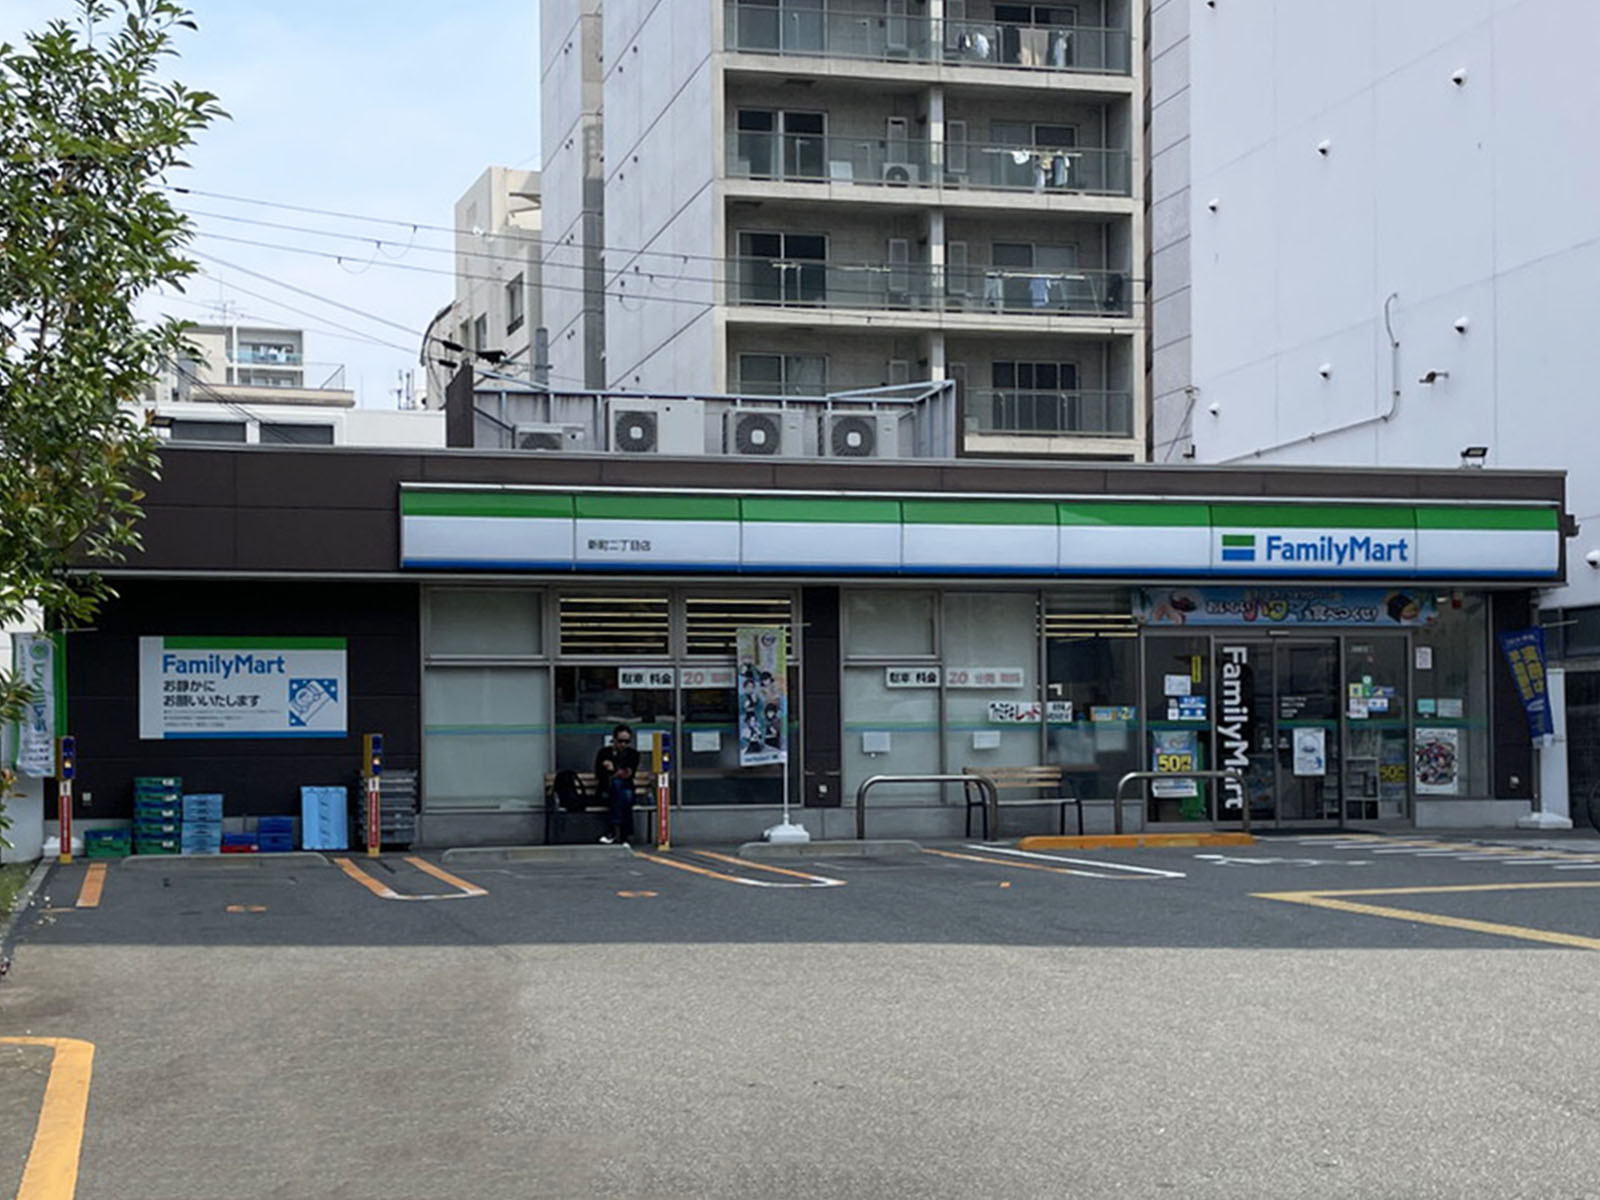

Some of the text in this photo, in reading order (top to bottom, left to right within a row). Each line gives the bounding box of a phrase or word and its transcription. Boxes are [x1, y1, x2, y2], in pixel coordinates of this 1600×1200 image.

[1266, 536, 1408, 565] FamilyMart
[162, 654, 285, 679] FamilyMart
[163, 680, 216, 692] お静かに
[163, 695, 260, 707] お願いいたします
[1217, 646, 1249, 809] FamilyMart
